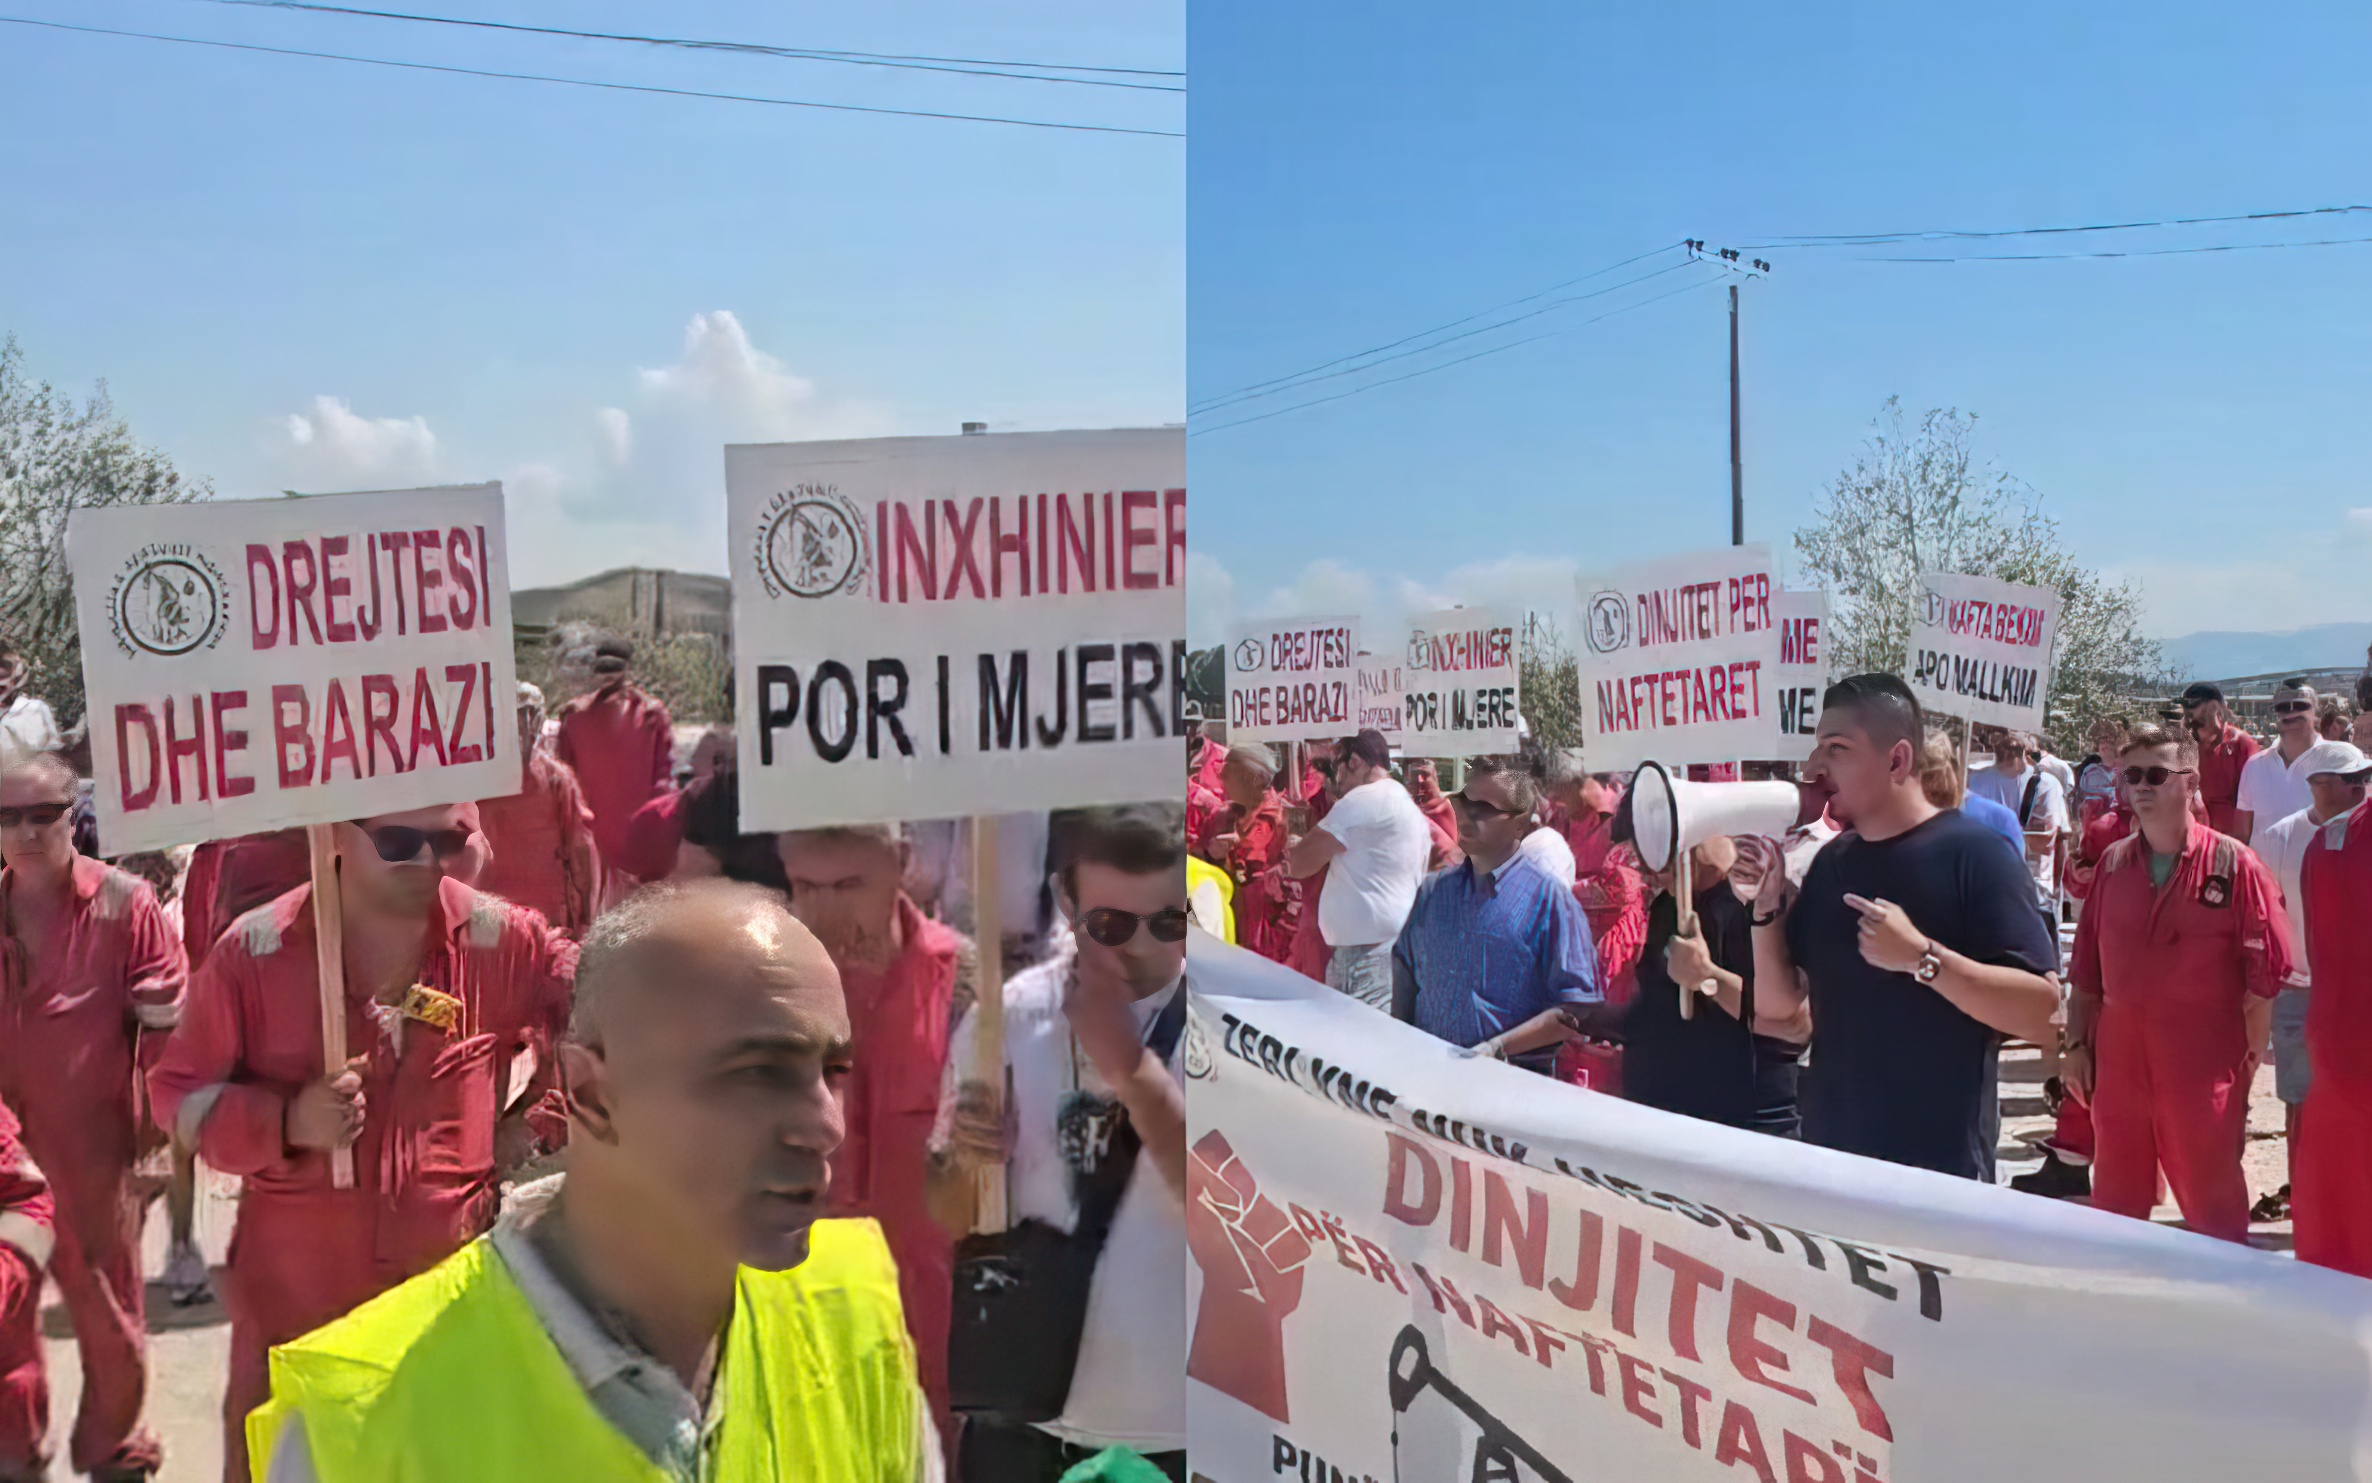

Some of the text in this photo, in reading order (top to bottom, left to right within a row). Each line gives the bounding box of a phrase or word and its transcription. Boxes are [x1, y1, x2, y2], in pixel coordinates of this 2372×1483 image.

[246, 525, 491, 650] DREJTESI
[876, 489, 1186, 603] INXHINIER
[1271, 627, 1350, 672] DREJTESI
[1638, 573, 1771, 647] DINJITET PER
[115, 661, 495, 813] DHE BARAZI
[757, 658, 914, 766] POR
[937, 655, 949, 755] I
[1233, 687, 1271, 728] DHE
[1276, 681, 1348, 725] BARAZI
[1406, 692, 1438, 731] POR
[1597, 661, 1761, 734] NAFTETARET
[1382, 1131, 1894, 1443] DINJITET
